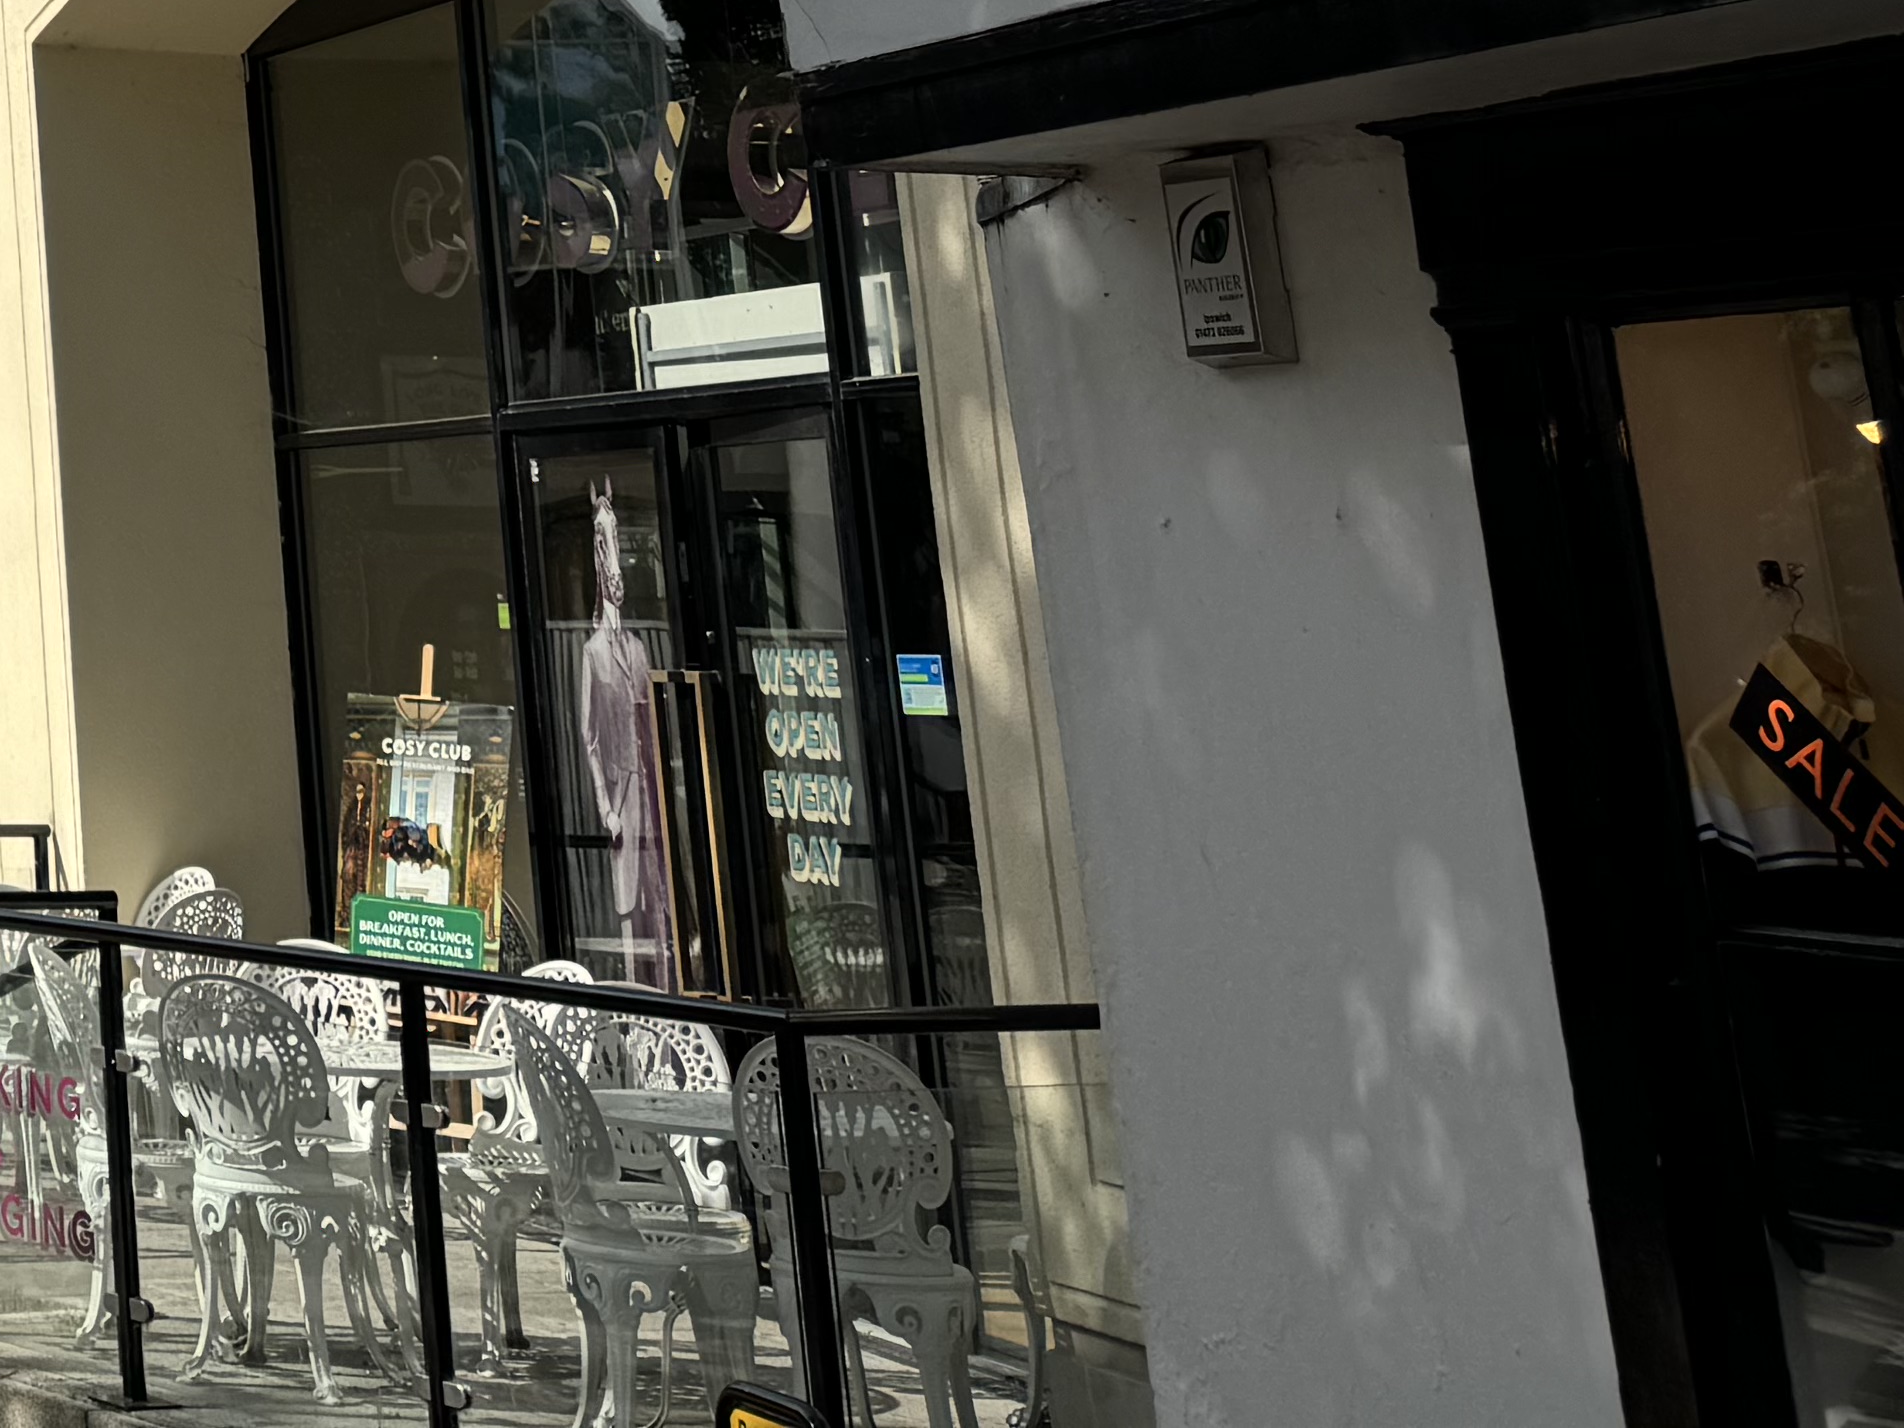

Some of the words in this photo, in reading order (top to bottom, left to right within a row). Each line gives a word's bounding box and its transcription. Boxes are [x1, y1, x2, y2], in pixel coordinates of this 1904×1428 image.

[1183, 274, 1243, 295] PANTHER
[752, 648, 842, 699] WE'RE
[382, 737, 425, 759] COSY
[429, 743, 472, 761] CLUB
[765, 708, 842, 762] OPEN
[763, 769, 853, 826] EVERY
[1758, 699, 1904, 868] SALE
[787, 833, 841, 887] DAY
[388, 909, 419, 925] OPEN
[421, 915, 445, 928] FOR
[406, 940, 473, 960] COCKTAILS
